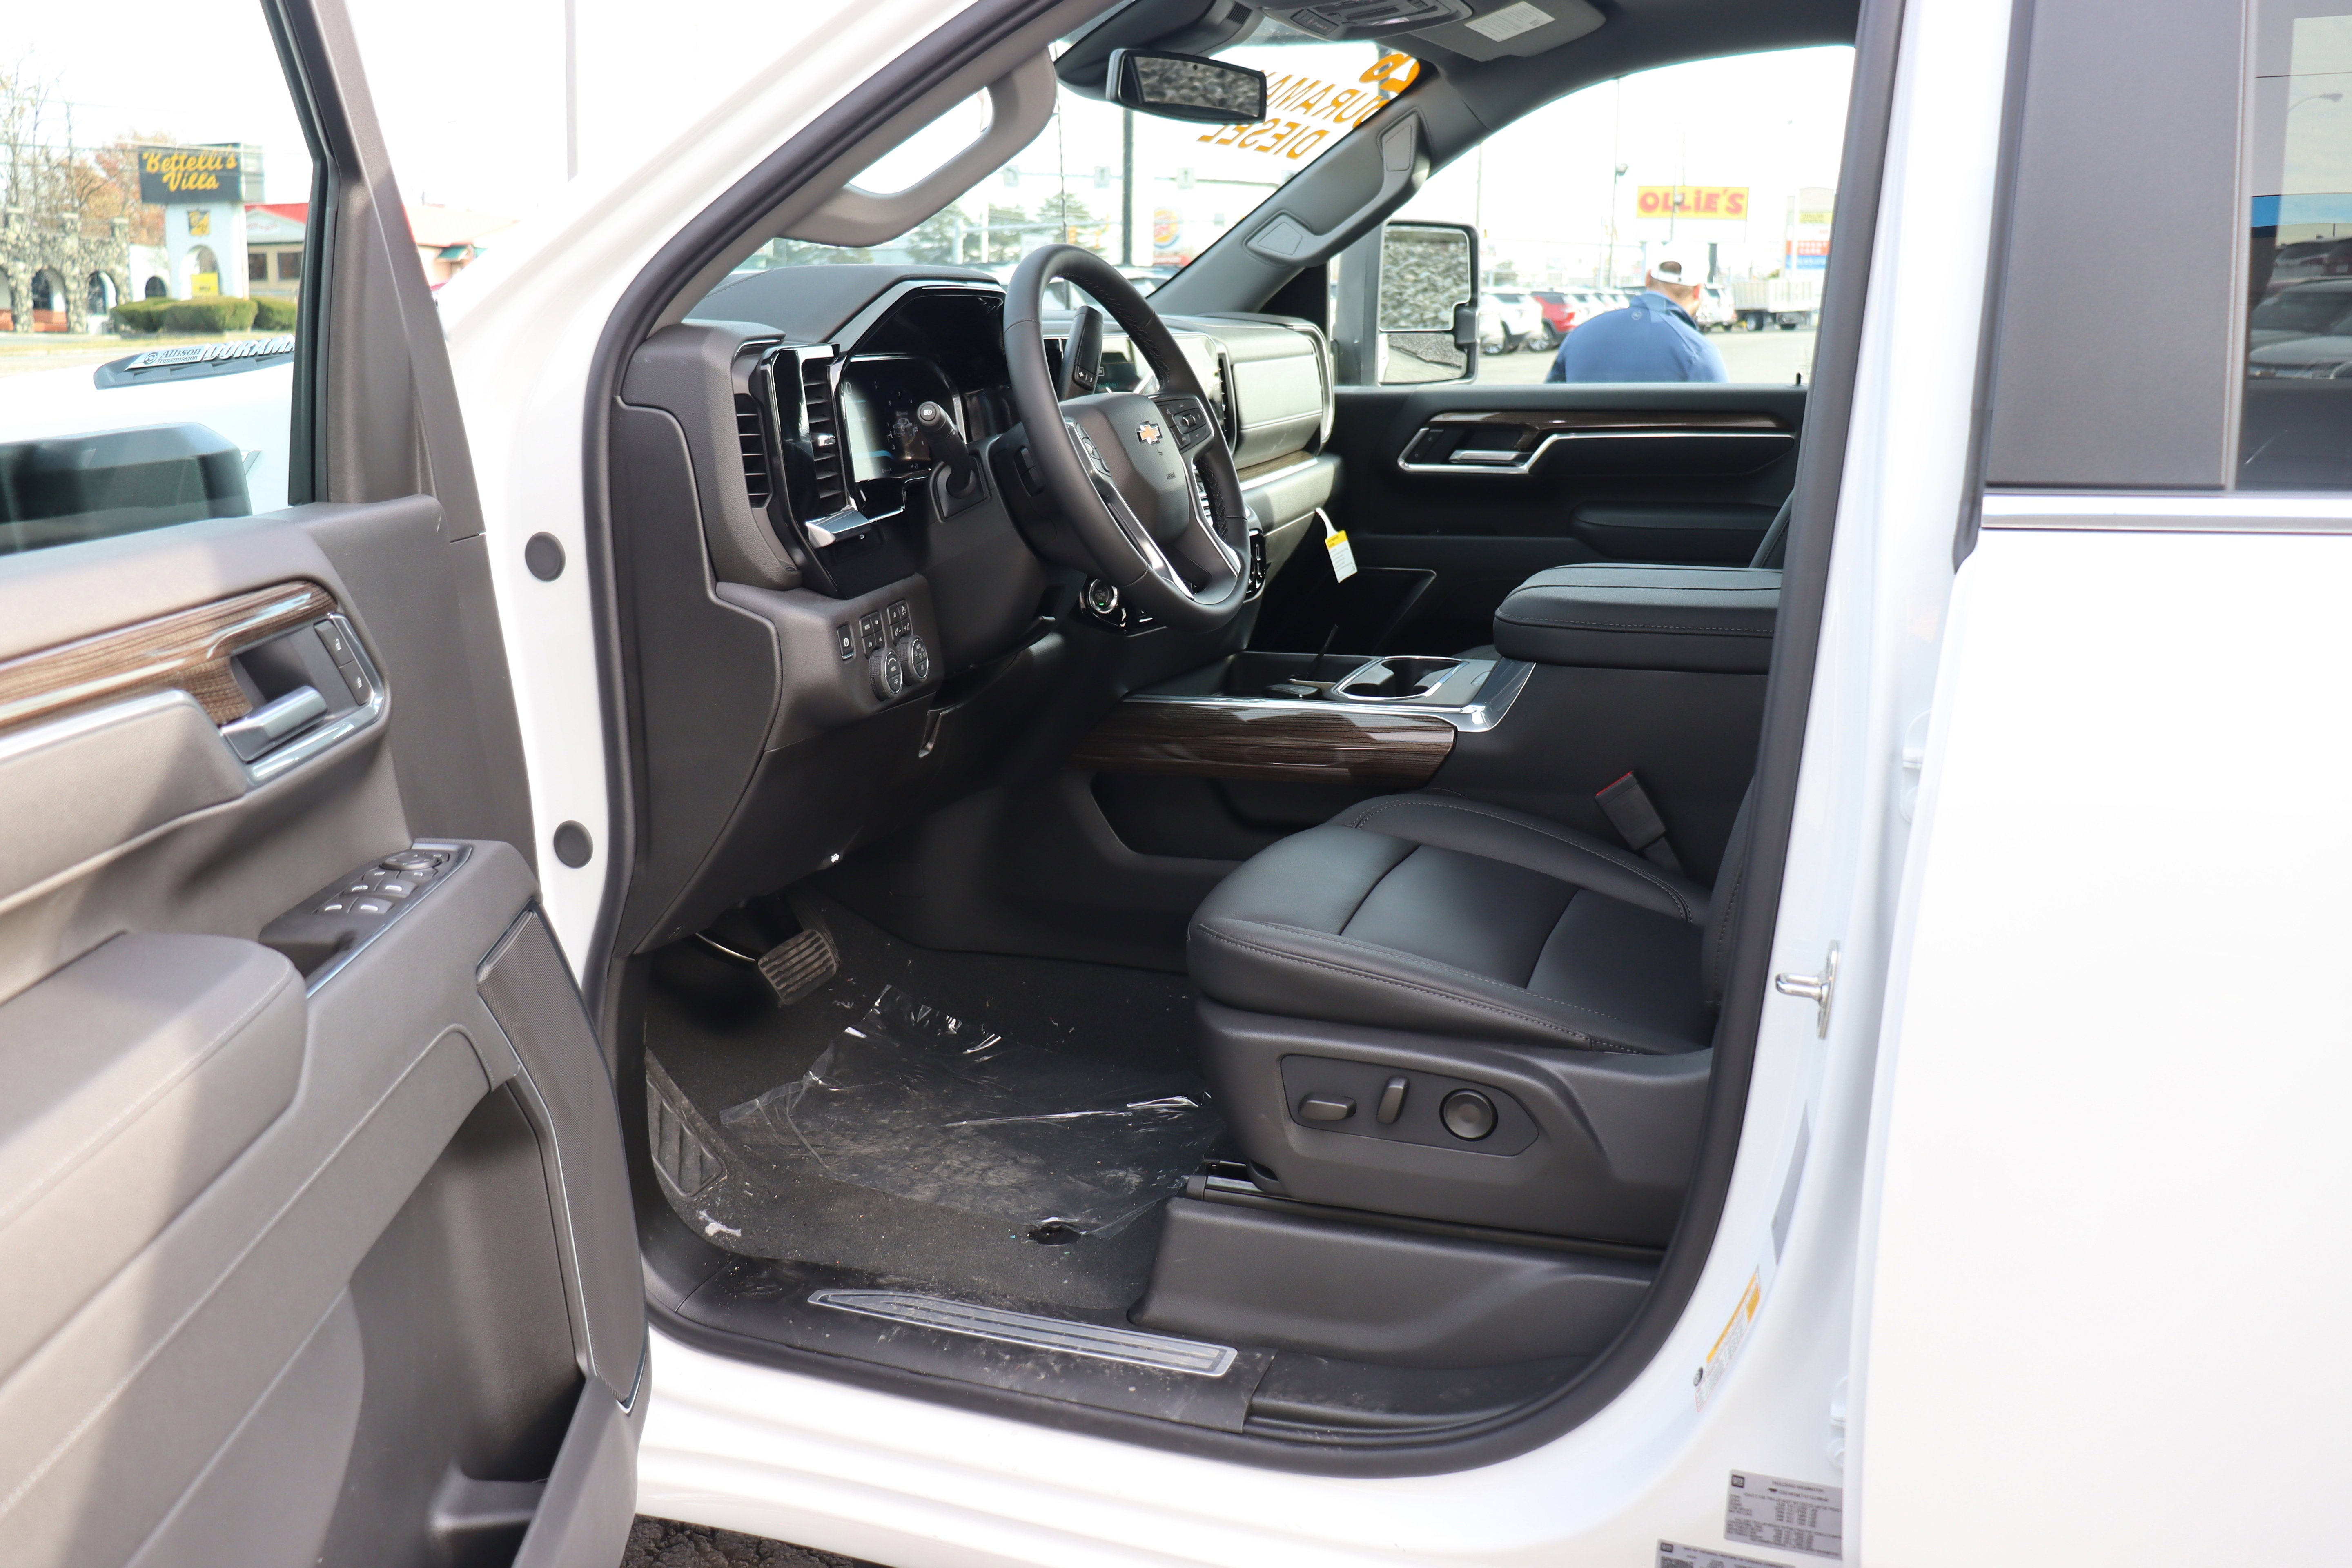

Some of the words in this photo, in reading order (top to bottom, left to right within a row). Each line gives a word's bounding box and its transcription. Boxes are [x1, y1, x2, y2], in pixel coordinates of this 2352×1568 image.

[142, 145, 238, 173] Bettelli's
[162, 172, 219, 192] Villa
[156, 356, 198, 364] Transmission
[160, 348, 201, 359] Allison
